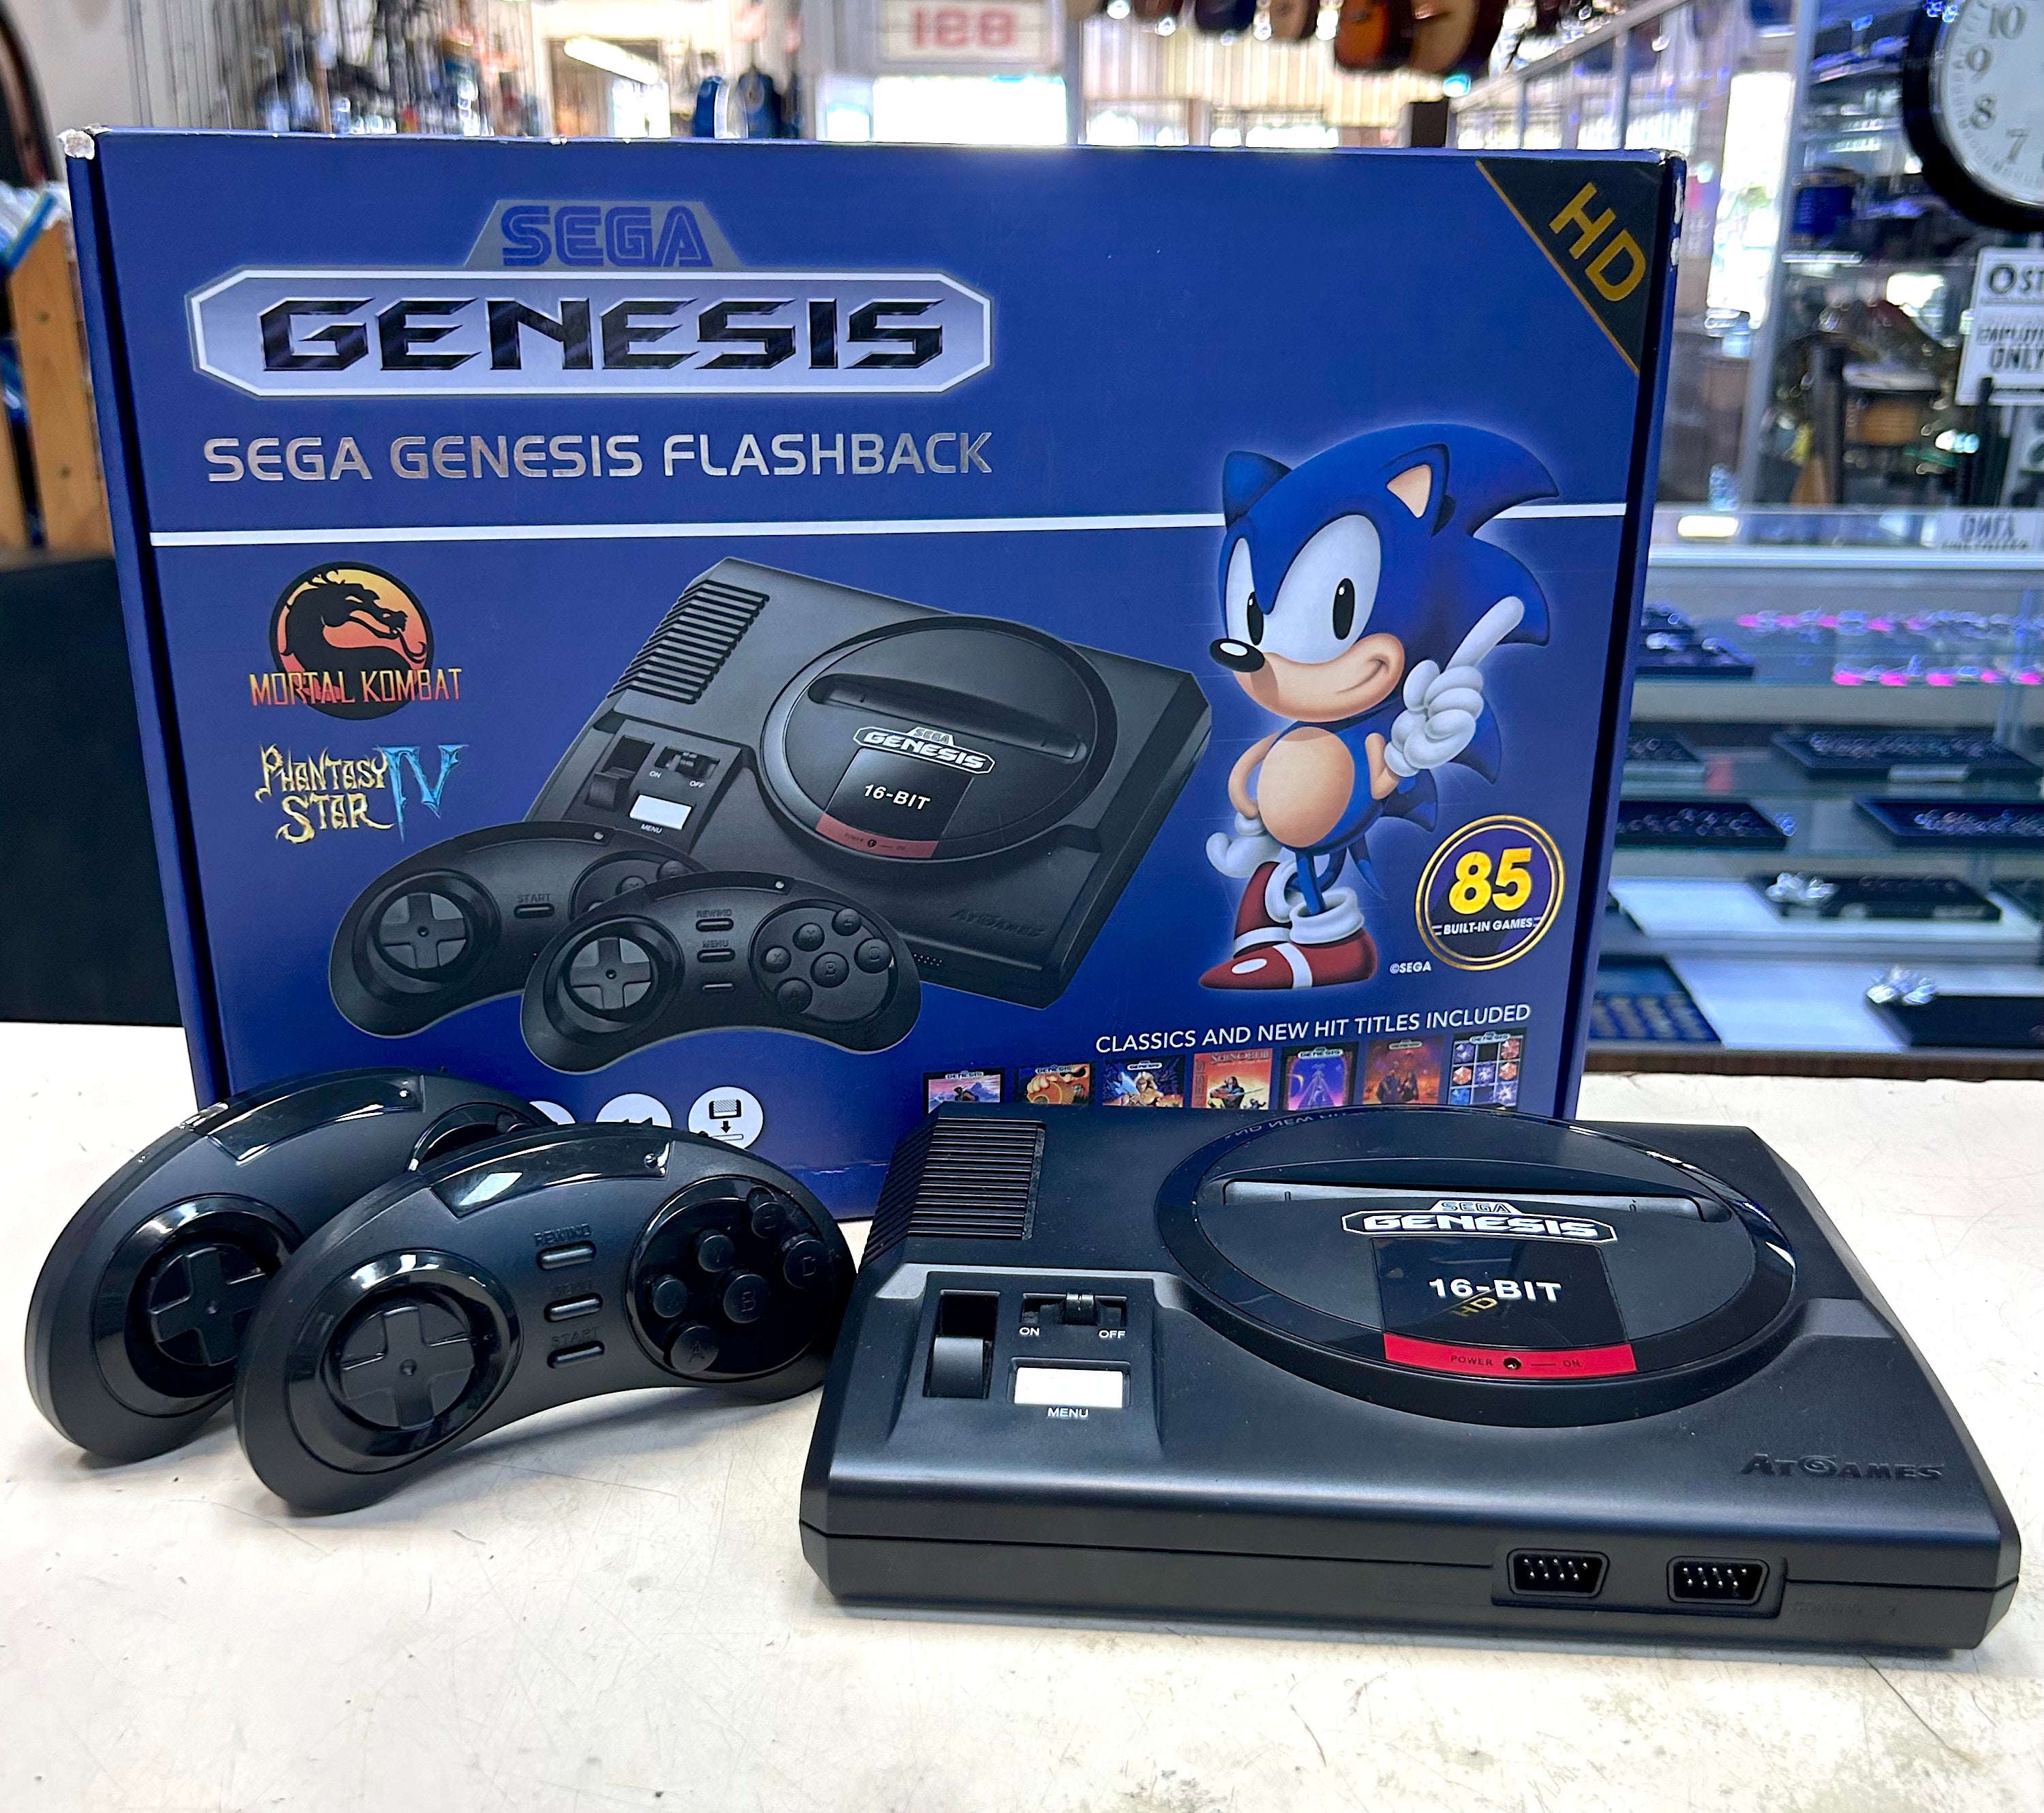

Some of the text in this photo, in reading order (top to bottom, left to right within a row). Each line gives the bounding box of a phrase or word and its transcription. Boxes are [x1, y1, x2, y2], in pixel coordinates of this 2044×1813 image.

[1988, 5, 2027, 40] 10
[1966, 43, 1993, 82] 9
[1970, 92, 1996, 130] 8
[2006, 127, 2029, 164] 7
[500, 206, 713, 266] SEGA
[1549, 182, 1647, 302] HD
[259, 296, 946, 371] GENESIS
[204, 431, 992, 482] SEGA GENESIS FLASHBACK
[249, 668, 462, 707] MORTAL KOMBAT
[913, 729, 949, 743] SEGA
[864, 731, 986, 769] GENESIS
[255, 743, 389, 803] PHANTASY
[649, 770, 662, 778] ON
[689, 780, 705, 789] OFF
[372, 744, 470, 842] IV
[864, 784, 931, 810] 16-BIT
[275, 792, 395, 844] STAR
[641, 823, 662, 834] MENU
[1448, 847, 1532, 915] 85
[517, 893, 552, 902] START
[1443, 917, 1534, 936] BUILT-IN GAMES
[825, 961, 836, 977] B
[1095, 1003, 1531, 1054] CLASSICS AND NEW HIT TITLES INCLUDED
[1442, 1202, 1512, 1213] SEGA
[533, 1223, 593, 1247] REWIND
[1363, 1214, 1599, 1238] GENESIS
[1429, 1277, 1562, 1302] 16-BIT
[1019, 1327, 1040, 1336] ON
[1099, 1330, 1126, 1339] OFF
[1450, 1354, 1581, 1368] POWER ON
[1047, 1407, 1089, 1418] MENU
